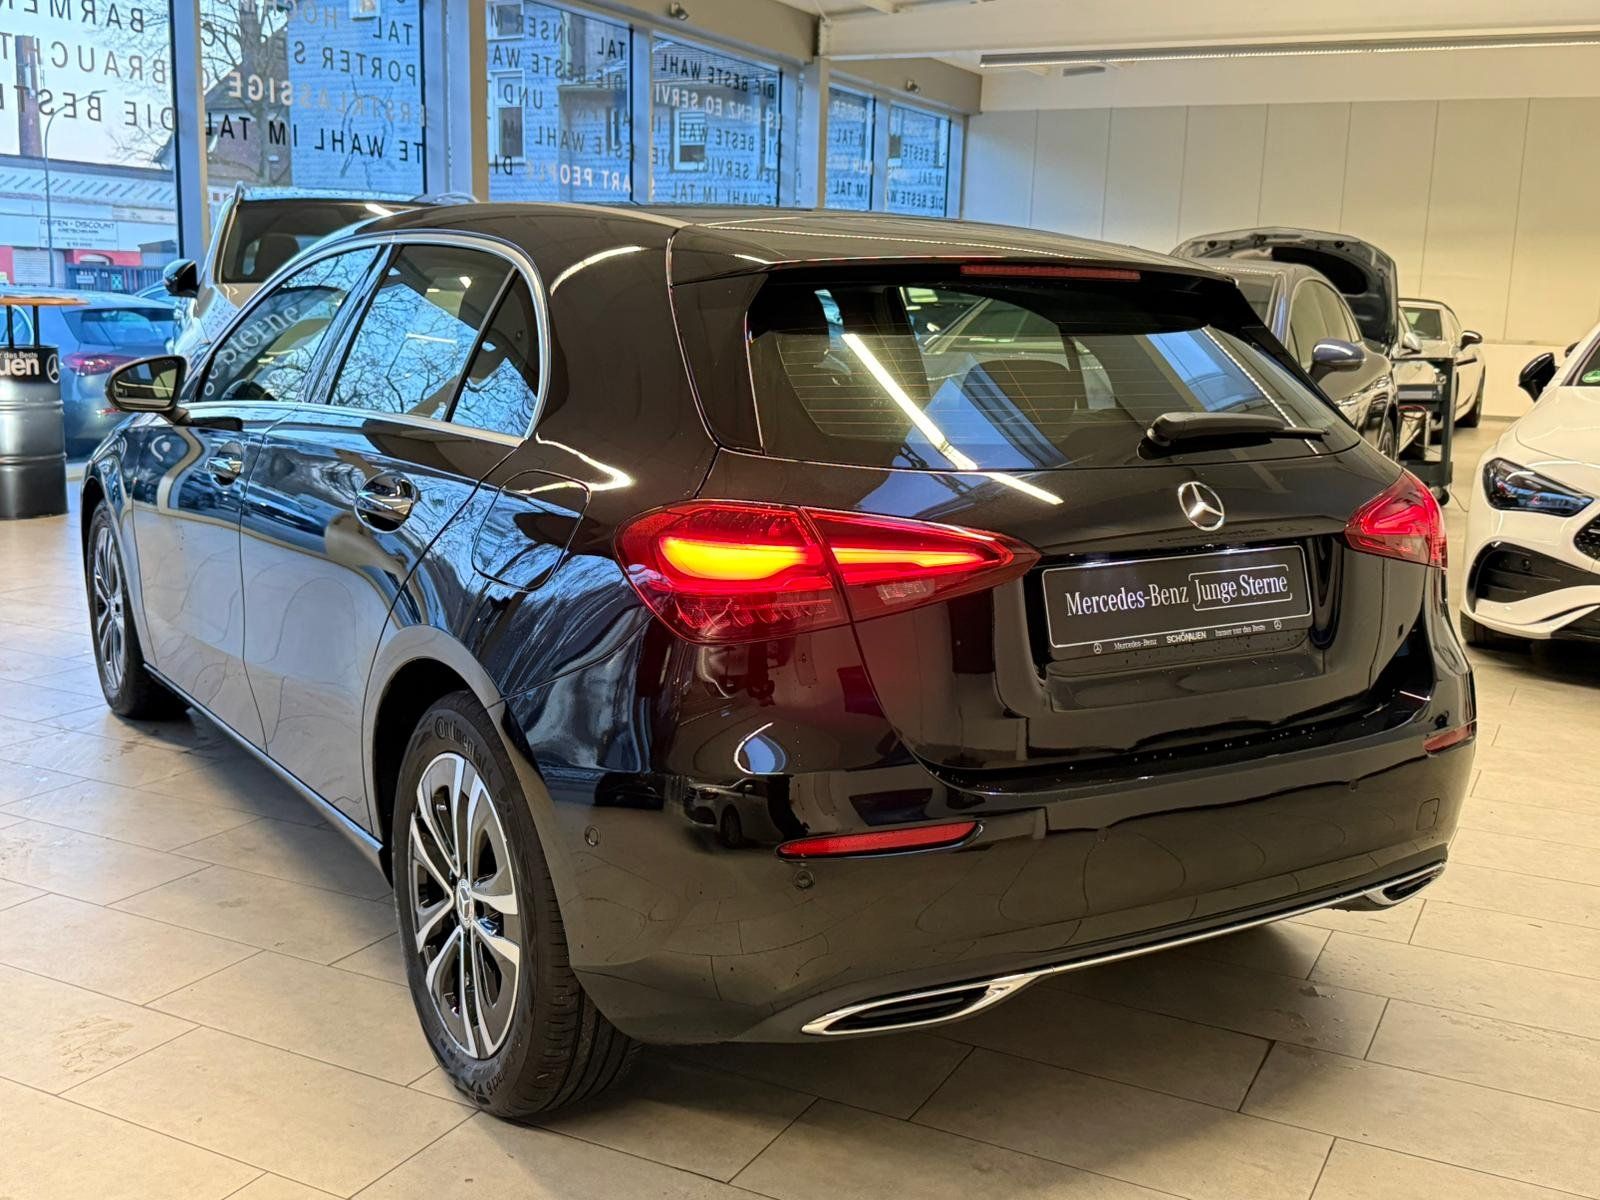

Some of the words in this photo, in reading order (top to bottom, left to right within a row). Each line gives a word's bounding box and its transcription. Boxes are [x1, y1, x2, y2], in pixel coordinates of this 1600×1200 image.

[1065, 583, 1189, 617] Mercedes-Benz
[1193, 578, 1238, 605] Junge
[1240, 573, 1288, 597] Sterne
